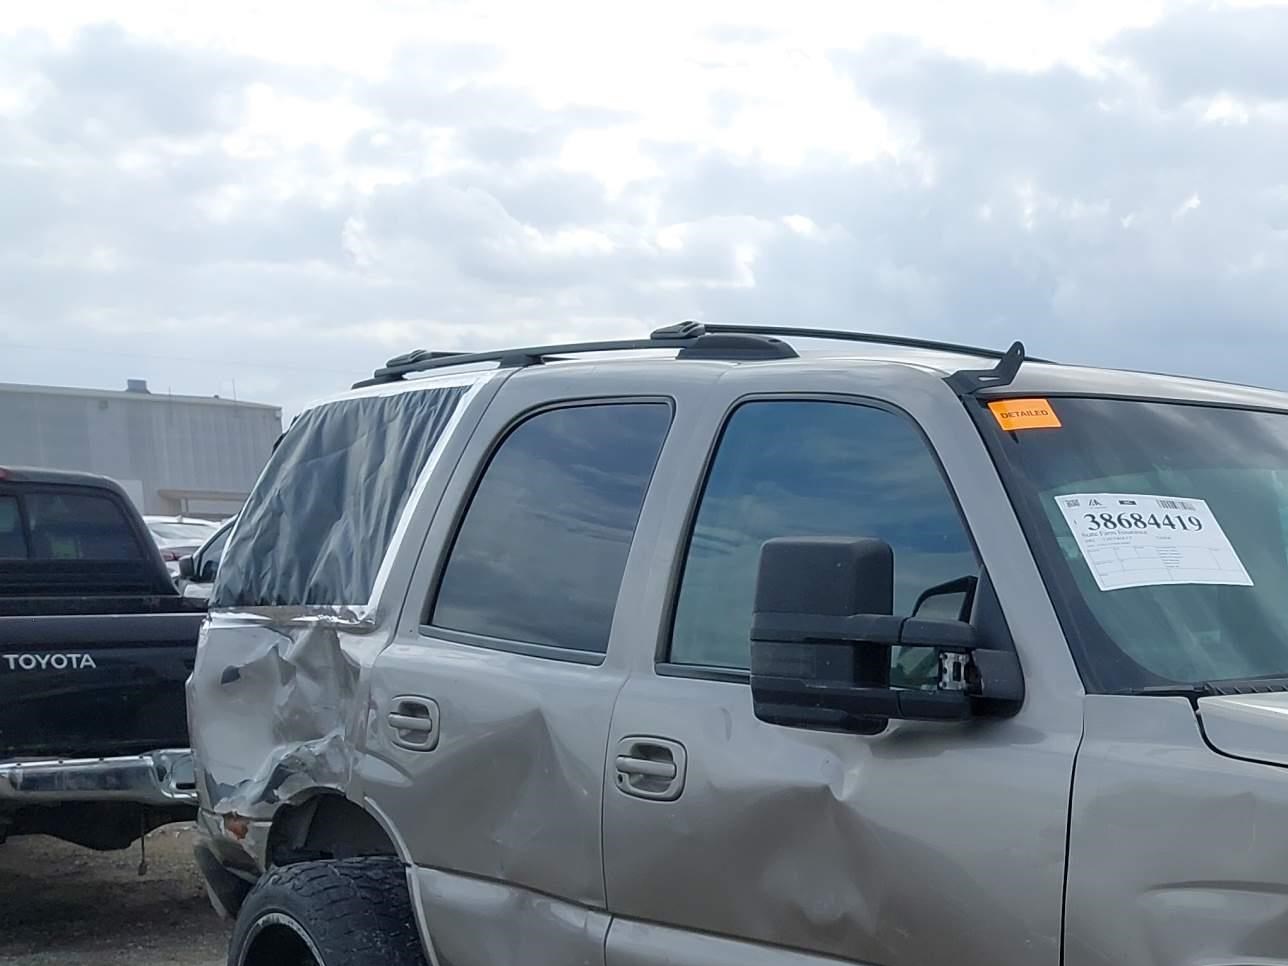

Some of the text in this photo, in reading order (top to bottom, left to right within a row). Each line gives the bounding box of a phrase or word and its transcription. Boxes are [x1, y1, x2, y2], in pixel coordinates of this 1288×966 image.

[1000, 410, 1049, 419] DETAILED
[1083, 512, 1203, 532] 38684419
[2, 653, 97, 670] TOYOTA
